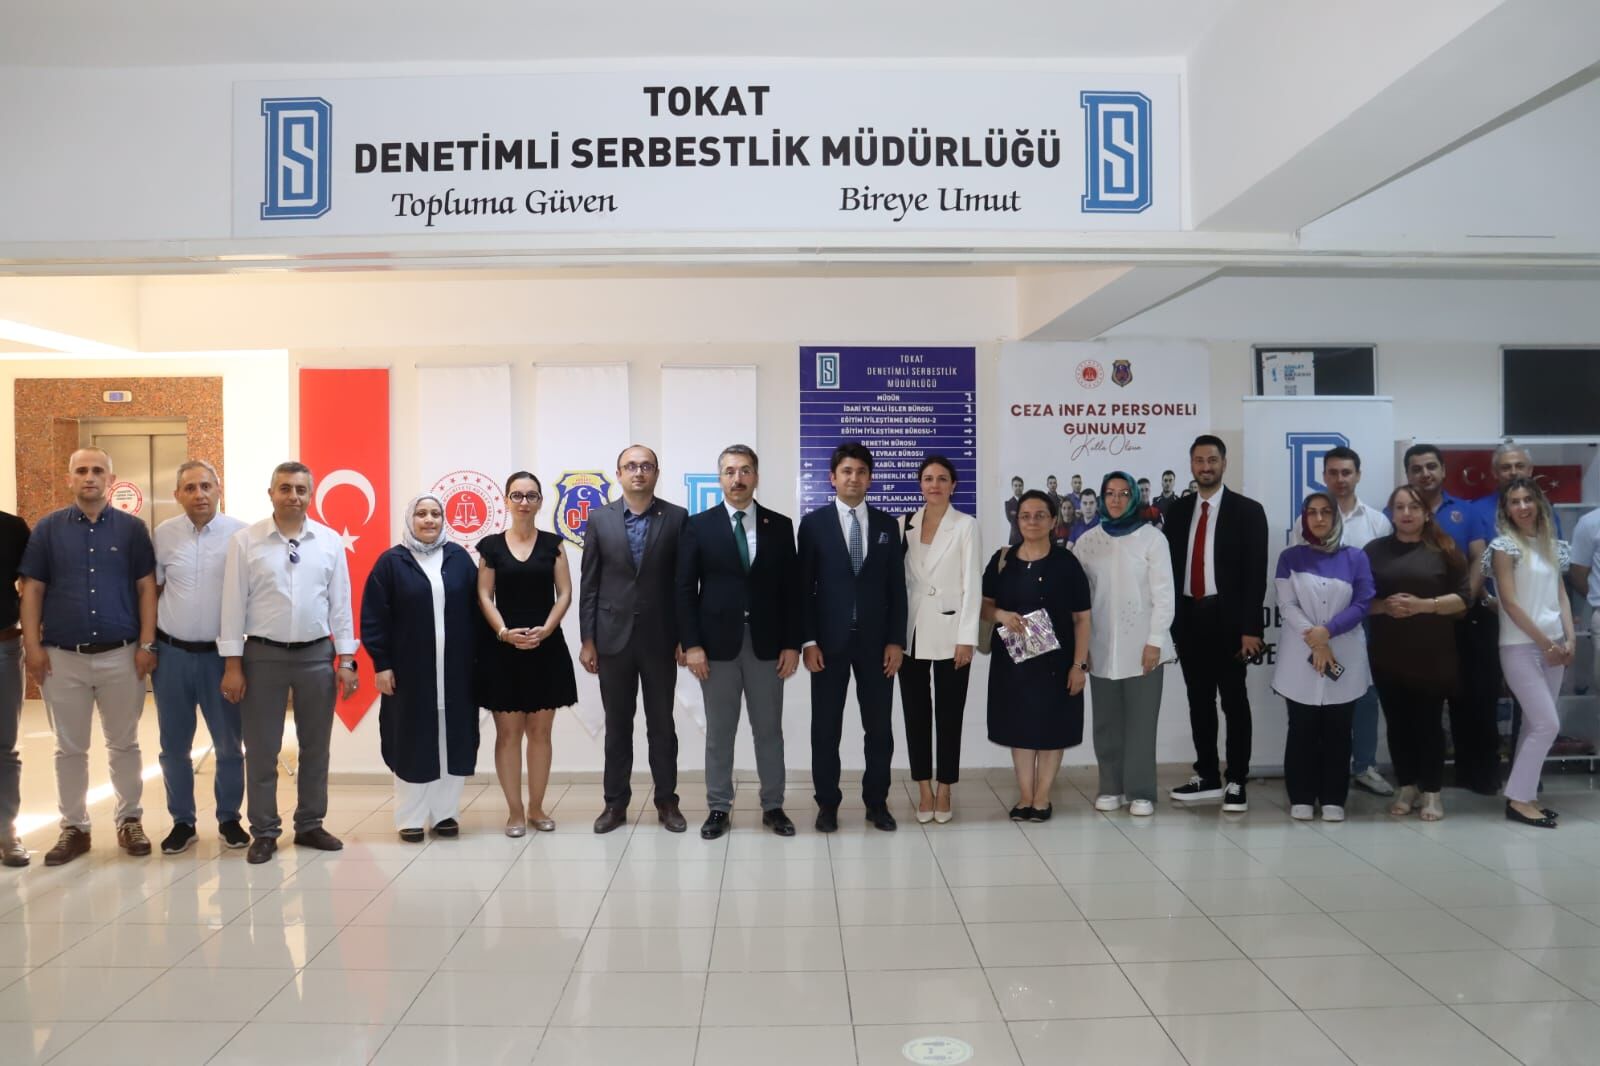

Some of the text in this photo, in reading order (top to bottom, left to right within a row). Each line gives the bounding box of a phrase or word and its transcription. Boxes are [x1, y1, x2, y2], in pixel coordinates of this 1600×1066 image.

[643, 86, 770, 116] TOKAT
[355, 128, 1060, 173] DENETİMLİ SERBESTLİK MÜDÜRLÜĞÜ
[392, 188, 618, 227] Topluma Güven
[840, 186, 1021, 222] Bireye Umut
[900, 355, 923, 363] TOKAT
[867, 366, 957, 376] DENETİMLİ SERBESTLİK
[887, 378, 937, 388] MÜDÜRLÜĞÜ
[877, 393, 900, 401] MÜDÜR
[843, 404, 861, 412] İDARİ
[871, 404, 887, 412] MALİ
[908, 404, 933, 412] BÜROSU
[1011, 404, 1054, 416] CEZA
[841, 415, 936, 425] EĞİTİM İYİLEŞTİRME BÜROSU-2
[841, 427, 936, 435] EĞİTİM İYİLEŞTİRME BÜROSU-1
[898, 449, 924, 457] BÜROSU
